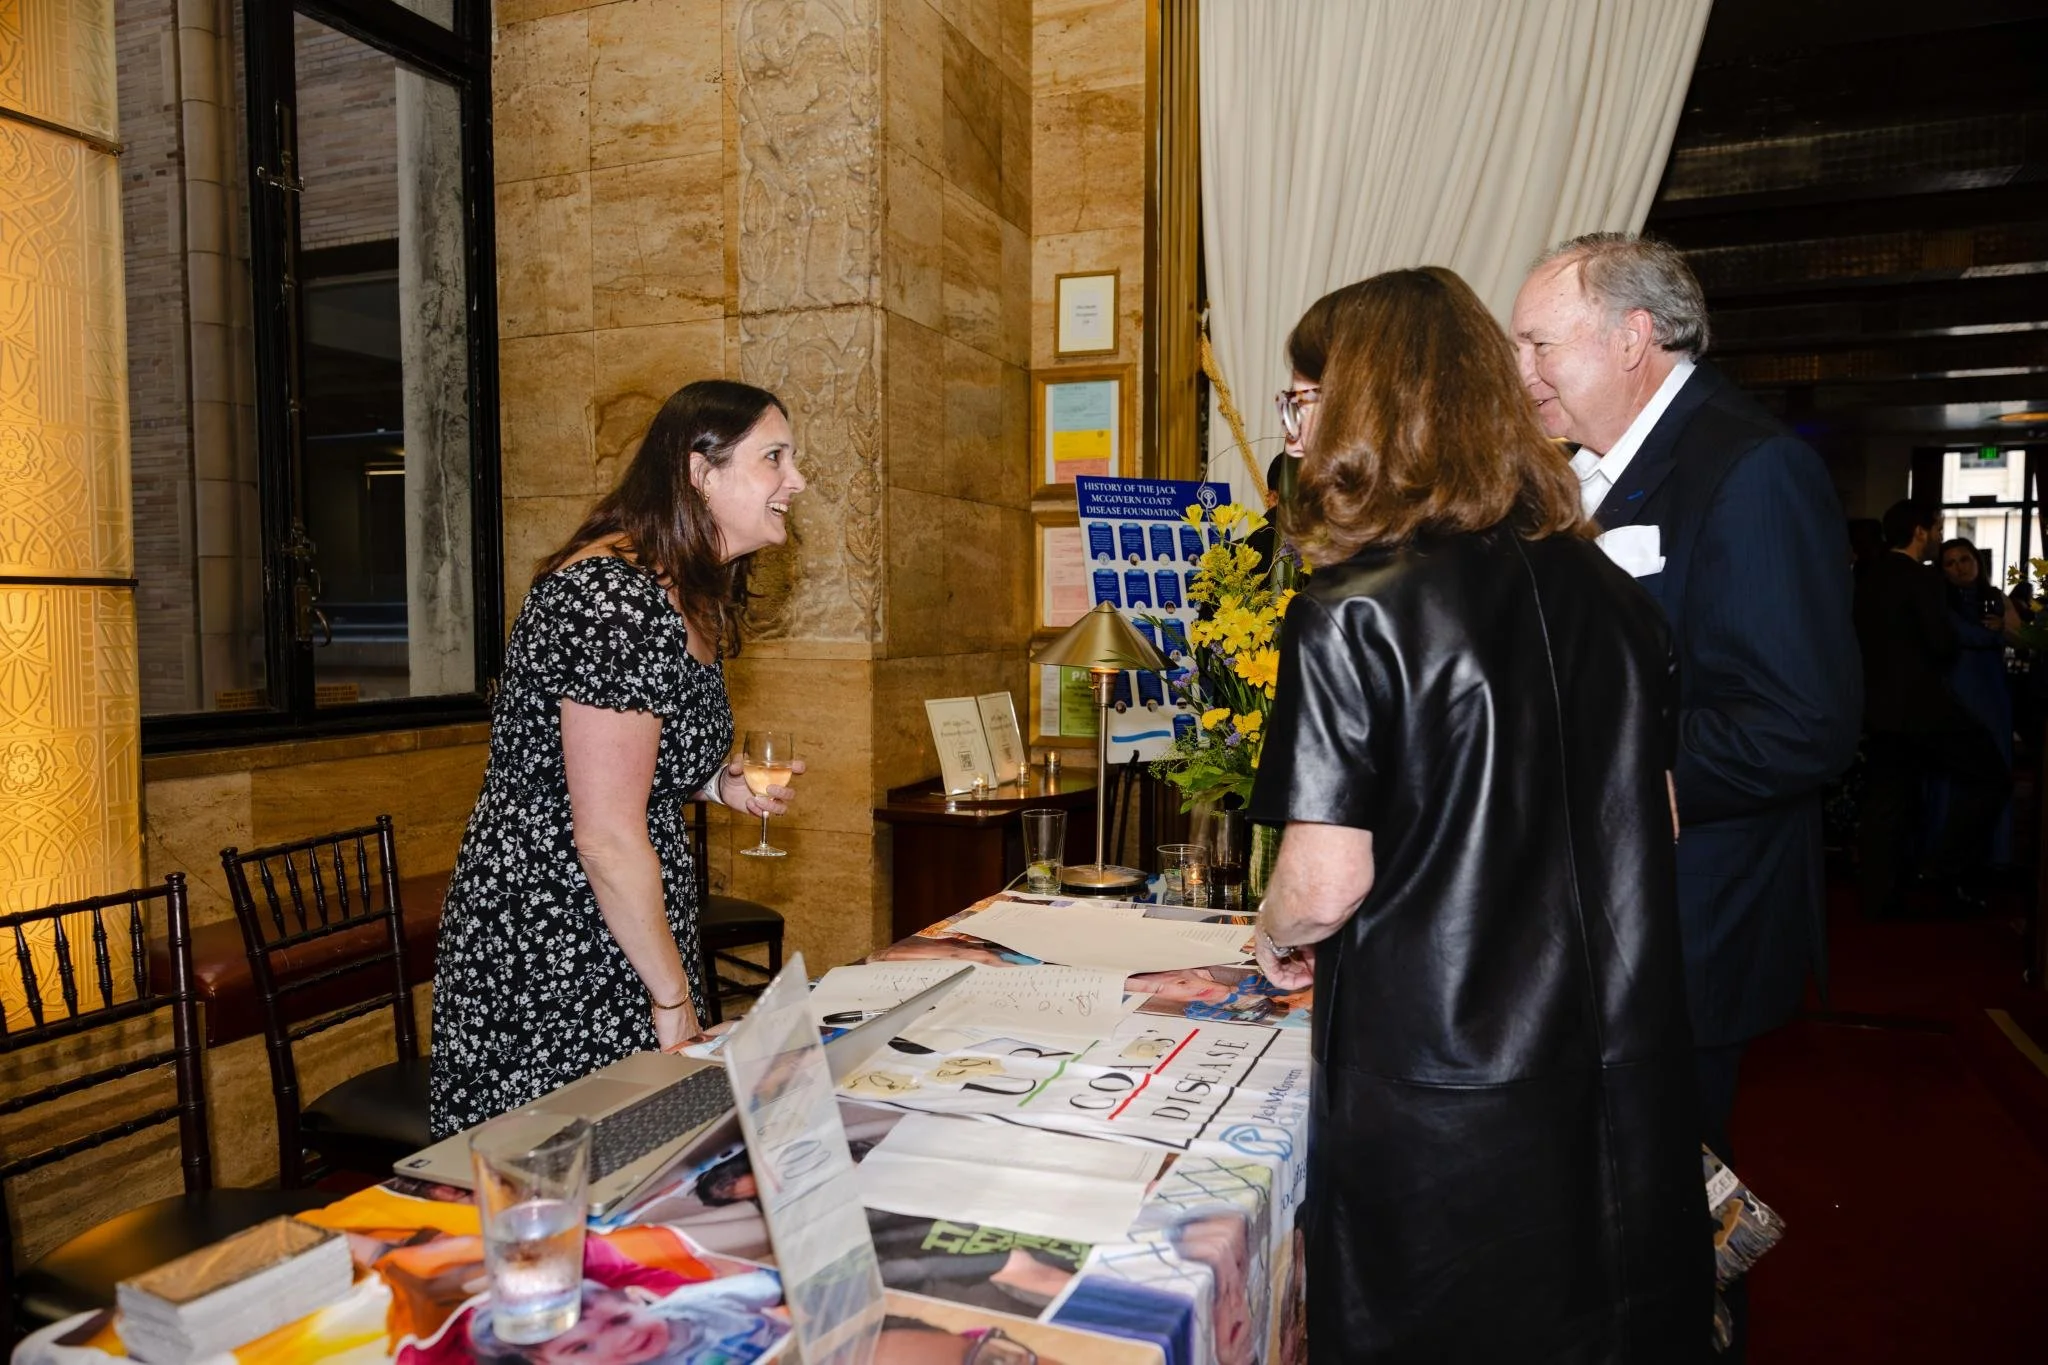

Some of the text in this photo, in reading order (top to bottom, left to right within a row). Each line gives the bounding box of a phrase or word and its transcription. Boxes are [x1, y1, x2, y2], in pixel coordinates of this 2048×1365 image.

[1084, 482, 1177, 496] HISTORY OF THE JACK
[1091, 494, 1142, 504] MCGOVERN
[1086, 505, 1180, 517] DISEASE FOUNDATION
[1151, 1039, 1249, 1121] DISEASE
